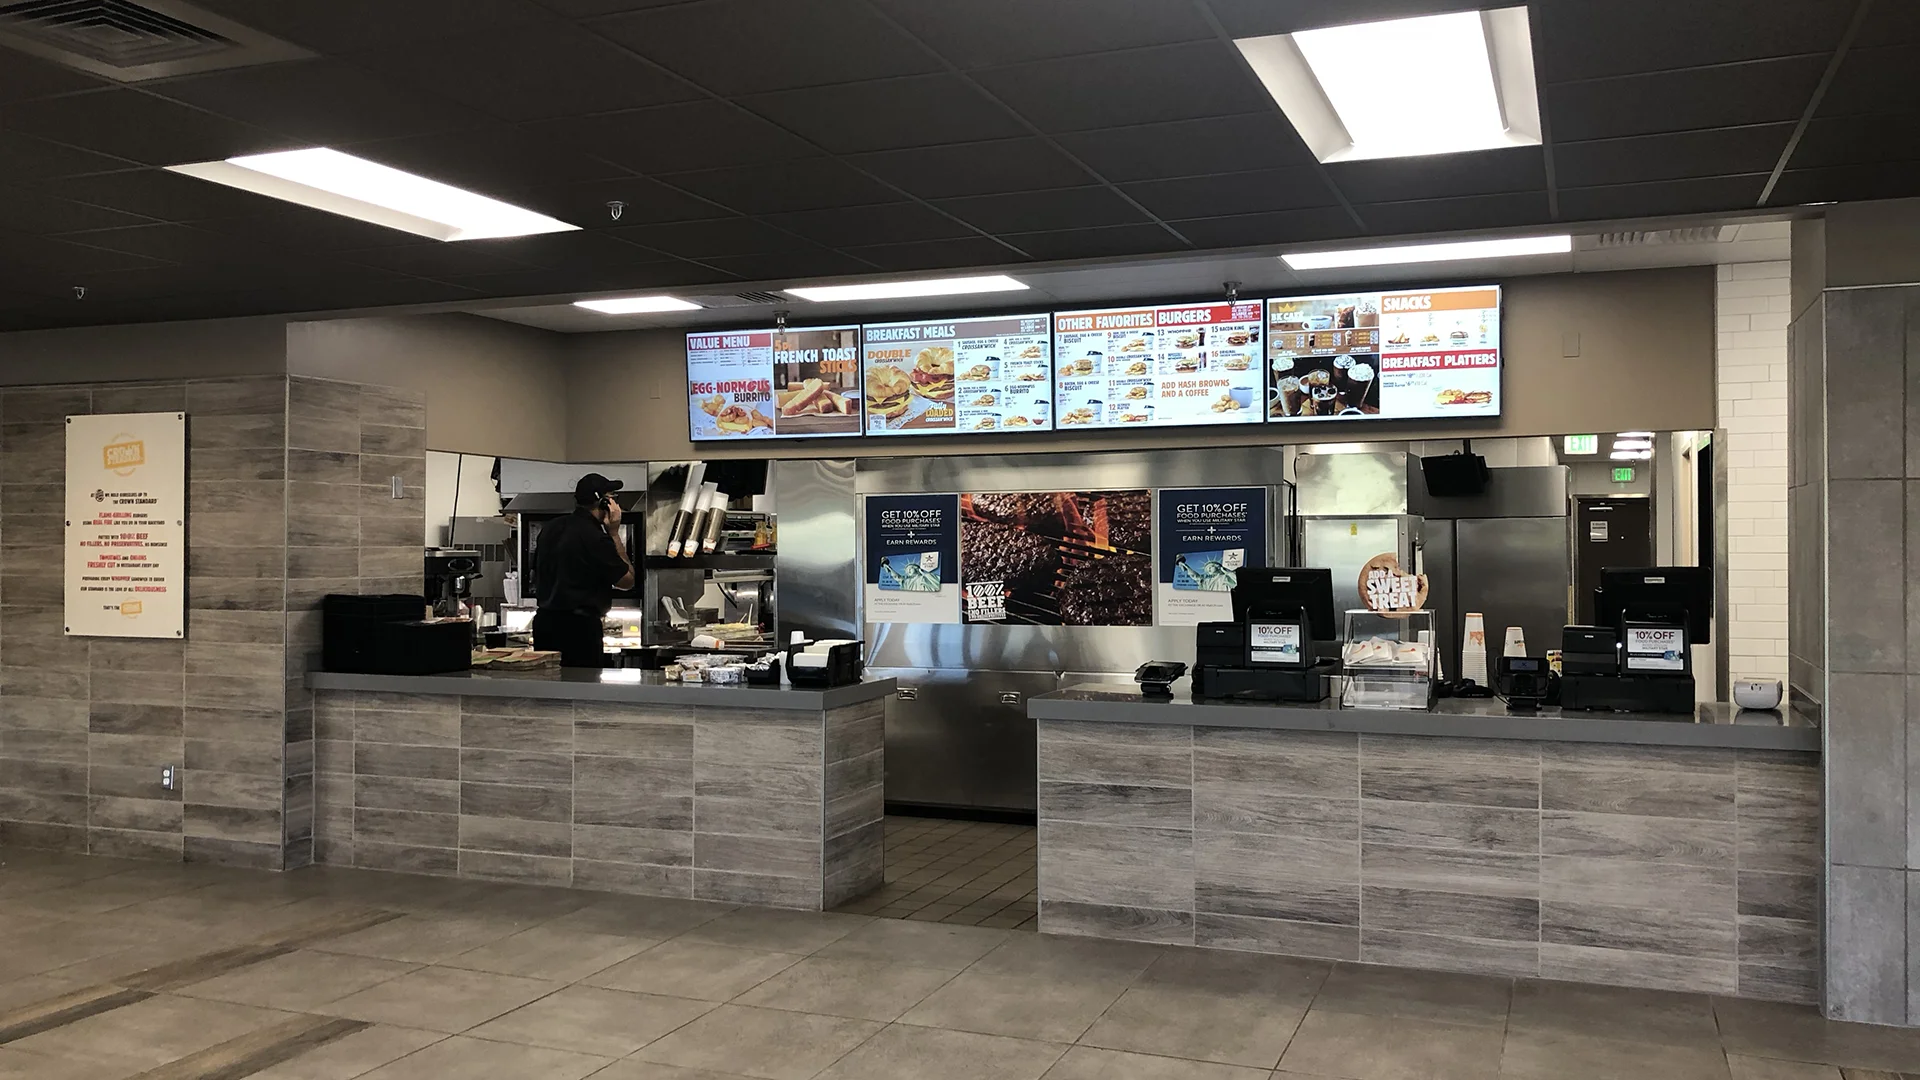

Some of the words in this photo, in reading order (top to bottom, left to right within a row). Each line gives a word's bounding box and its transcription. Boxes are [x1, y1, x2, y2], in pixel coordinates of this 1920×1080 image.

[1383, 295, 1432, 311] SNACKS
[1058, 317, 1093, 331] OTHER
[1095, 312, 1153, 329] FAVORITES
[1158, 309, 1211, 324] BURGERS
[1271, 312, 1283, 321] BK
[866, 328, 920, 341] BREAKFAST
[923, 325, 956, 339] MEALS
[690, 337, 720, 349] VALUE
[722, 336, 750, 348] MENU
[774, 340, 791, 351] 5p
[774, 349, 819, 364] FRENCH
[822, 347, 857, 361] TOAST
[867, 349, 912, 359] DOUBLE
[1382, 355, 1441, 369] BREAKFAST
[1444, 353, 1496, 367] PLATTERS
[820, 359, 857, 373] STICKS
[692, 380, 770, 395] EGG-NORMOUS
[1161, 381, 1176, 389] ADD
[1178, 380, 1197, 389] HASH
[1199, 379, 1230, 388] BROWNS
[734, 392, 771, 403] BURRITO
[1161, 390, 1176, 398] AND
[1185, 389, 1209, 397] COFFEE
[925, 409, 954, 417] LOADED
[1570, 436, 1591, 451] EXIT
[1614, 467, 1632, 481] EXIT
[881, 510, 901, 519] GET
[903, 510, 920, 518] 10%
[920, 509, 942, 518] OFF
[1176, 504, 1200, 513] GET
[1202, 504, 1222, 513] 10%
[1222, 503, 1247, 512] OFF
[1368, 570, 1386, 580] ADD
[1387, 569, 1394, 578] A
[965, 583, 1005, 598] 100%
[1366, 575, 1418, 595] SWEET
[967, 595, 1006, 609] BEEF
[1369, 591, 1417, 609] TREAT
[1258, 626, 1273, 635] 10%
[1273, 626, 1293, 635] OFF
[1635, 631, 1653, 639] 10%
[1653, 631, 1675, 640] OFF
